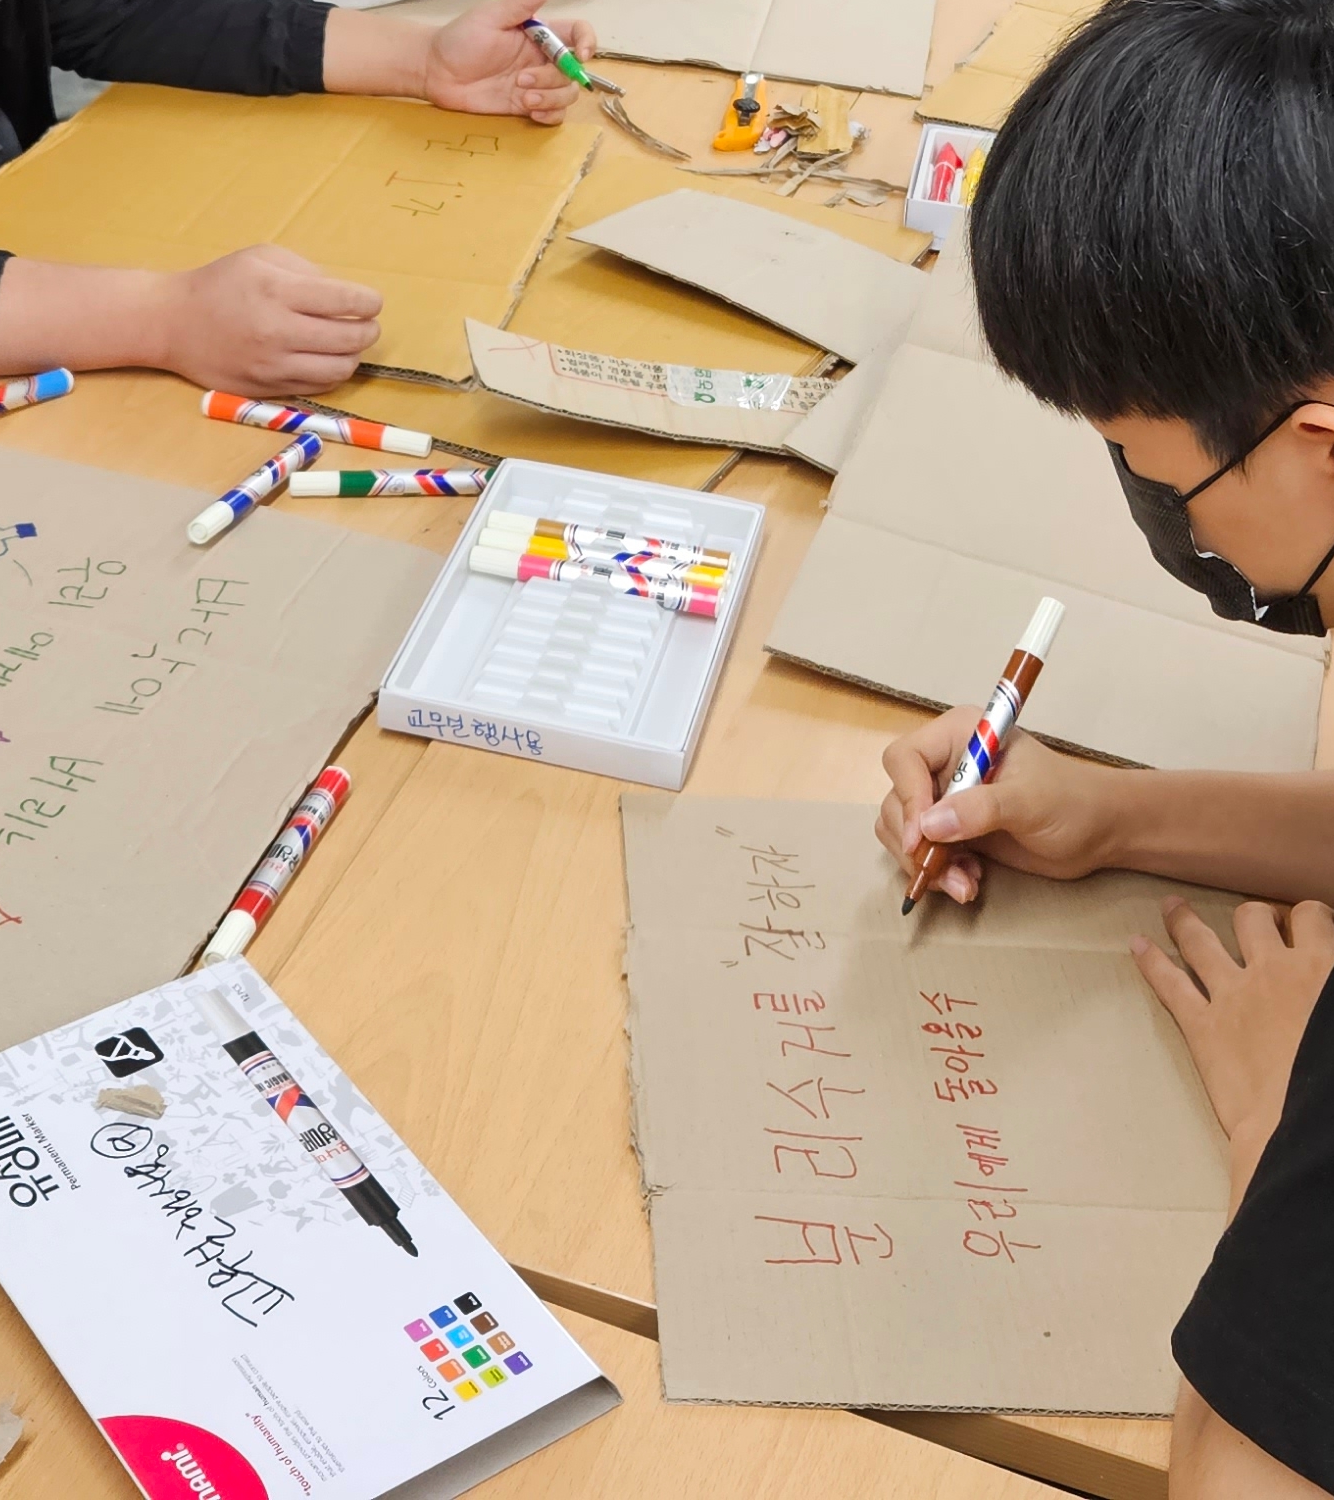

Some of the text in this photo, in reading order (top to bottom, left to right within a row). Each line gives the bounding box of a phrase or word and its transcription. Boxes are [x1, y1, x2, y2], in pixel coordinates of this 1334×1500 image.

[19, 1111, 81, 1191] Permanent Marker
[250, 1383, 270, 1406] human
[416, 1365, 456, 1420] 12 Colors
[278, 1453, 292, 1468] of
